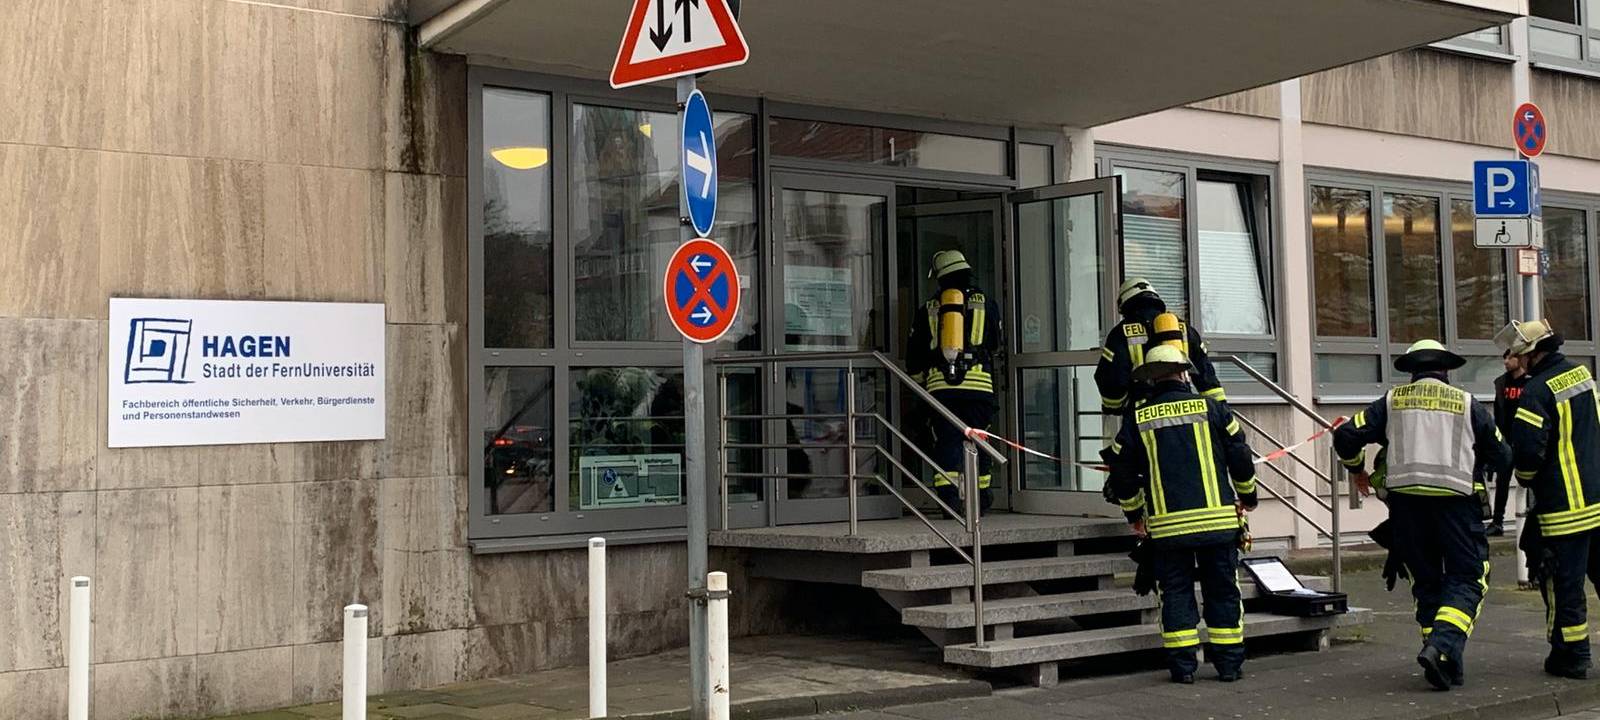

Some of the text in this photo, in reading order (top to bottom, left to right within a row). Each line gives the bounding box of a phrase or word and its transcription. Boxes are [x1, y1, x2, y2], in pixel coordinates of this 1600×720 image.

[1487, 168, 1515, 208] P
[202, 335, 291, 357] HAGEN
[203, 362, 375, 378] Stadt der FernUniversität
[122, 396, 376, 409] Fachbereich öffentliche Sicherheit, Verkehr, Bürgerdienste
[1138, 401, 1205, 421] FEUERWEHR
[122, 409, 241, 421] und Personenstandwesen
